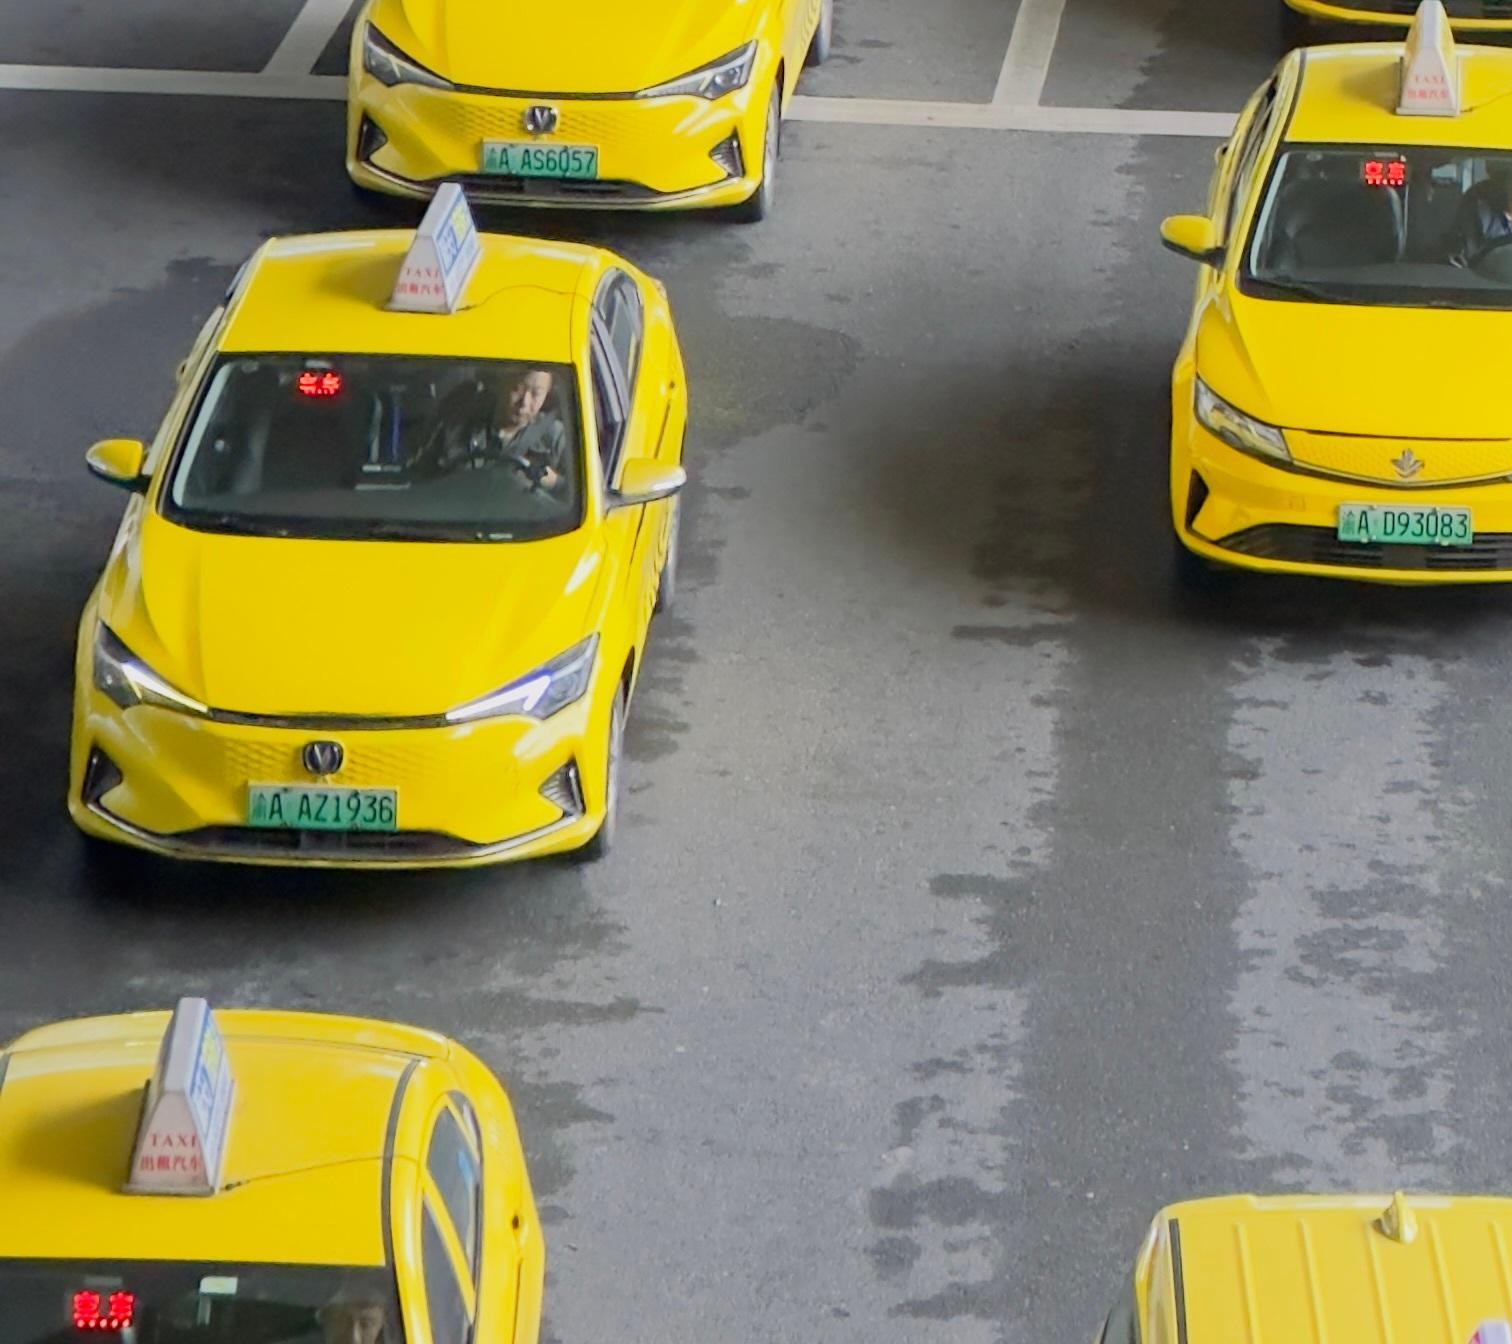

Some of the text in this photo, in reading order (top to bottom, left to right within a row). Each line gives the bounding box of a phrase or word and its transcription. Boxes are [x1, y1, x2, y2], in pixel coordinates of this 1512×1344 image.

[520, 148, 595, 173] AS6057
[1383, 511, 1468, 538] D93083
[298, 793, 394, 824] AZ1936
[150, 1133, 198, 1148] TAXI
[139, 1153, 200, 1173] 出租汽车
